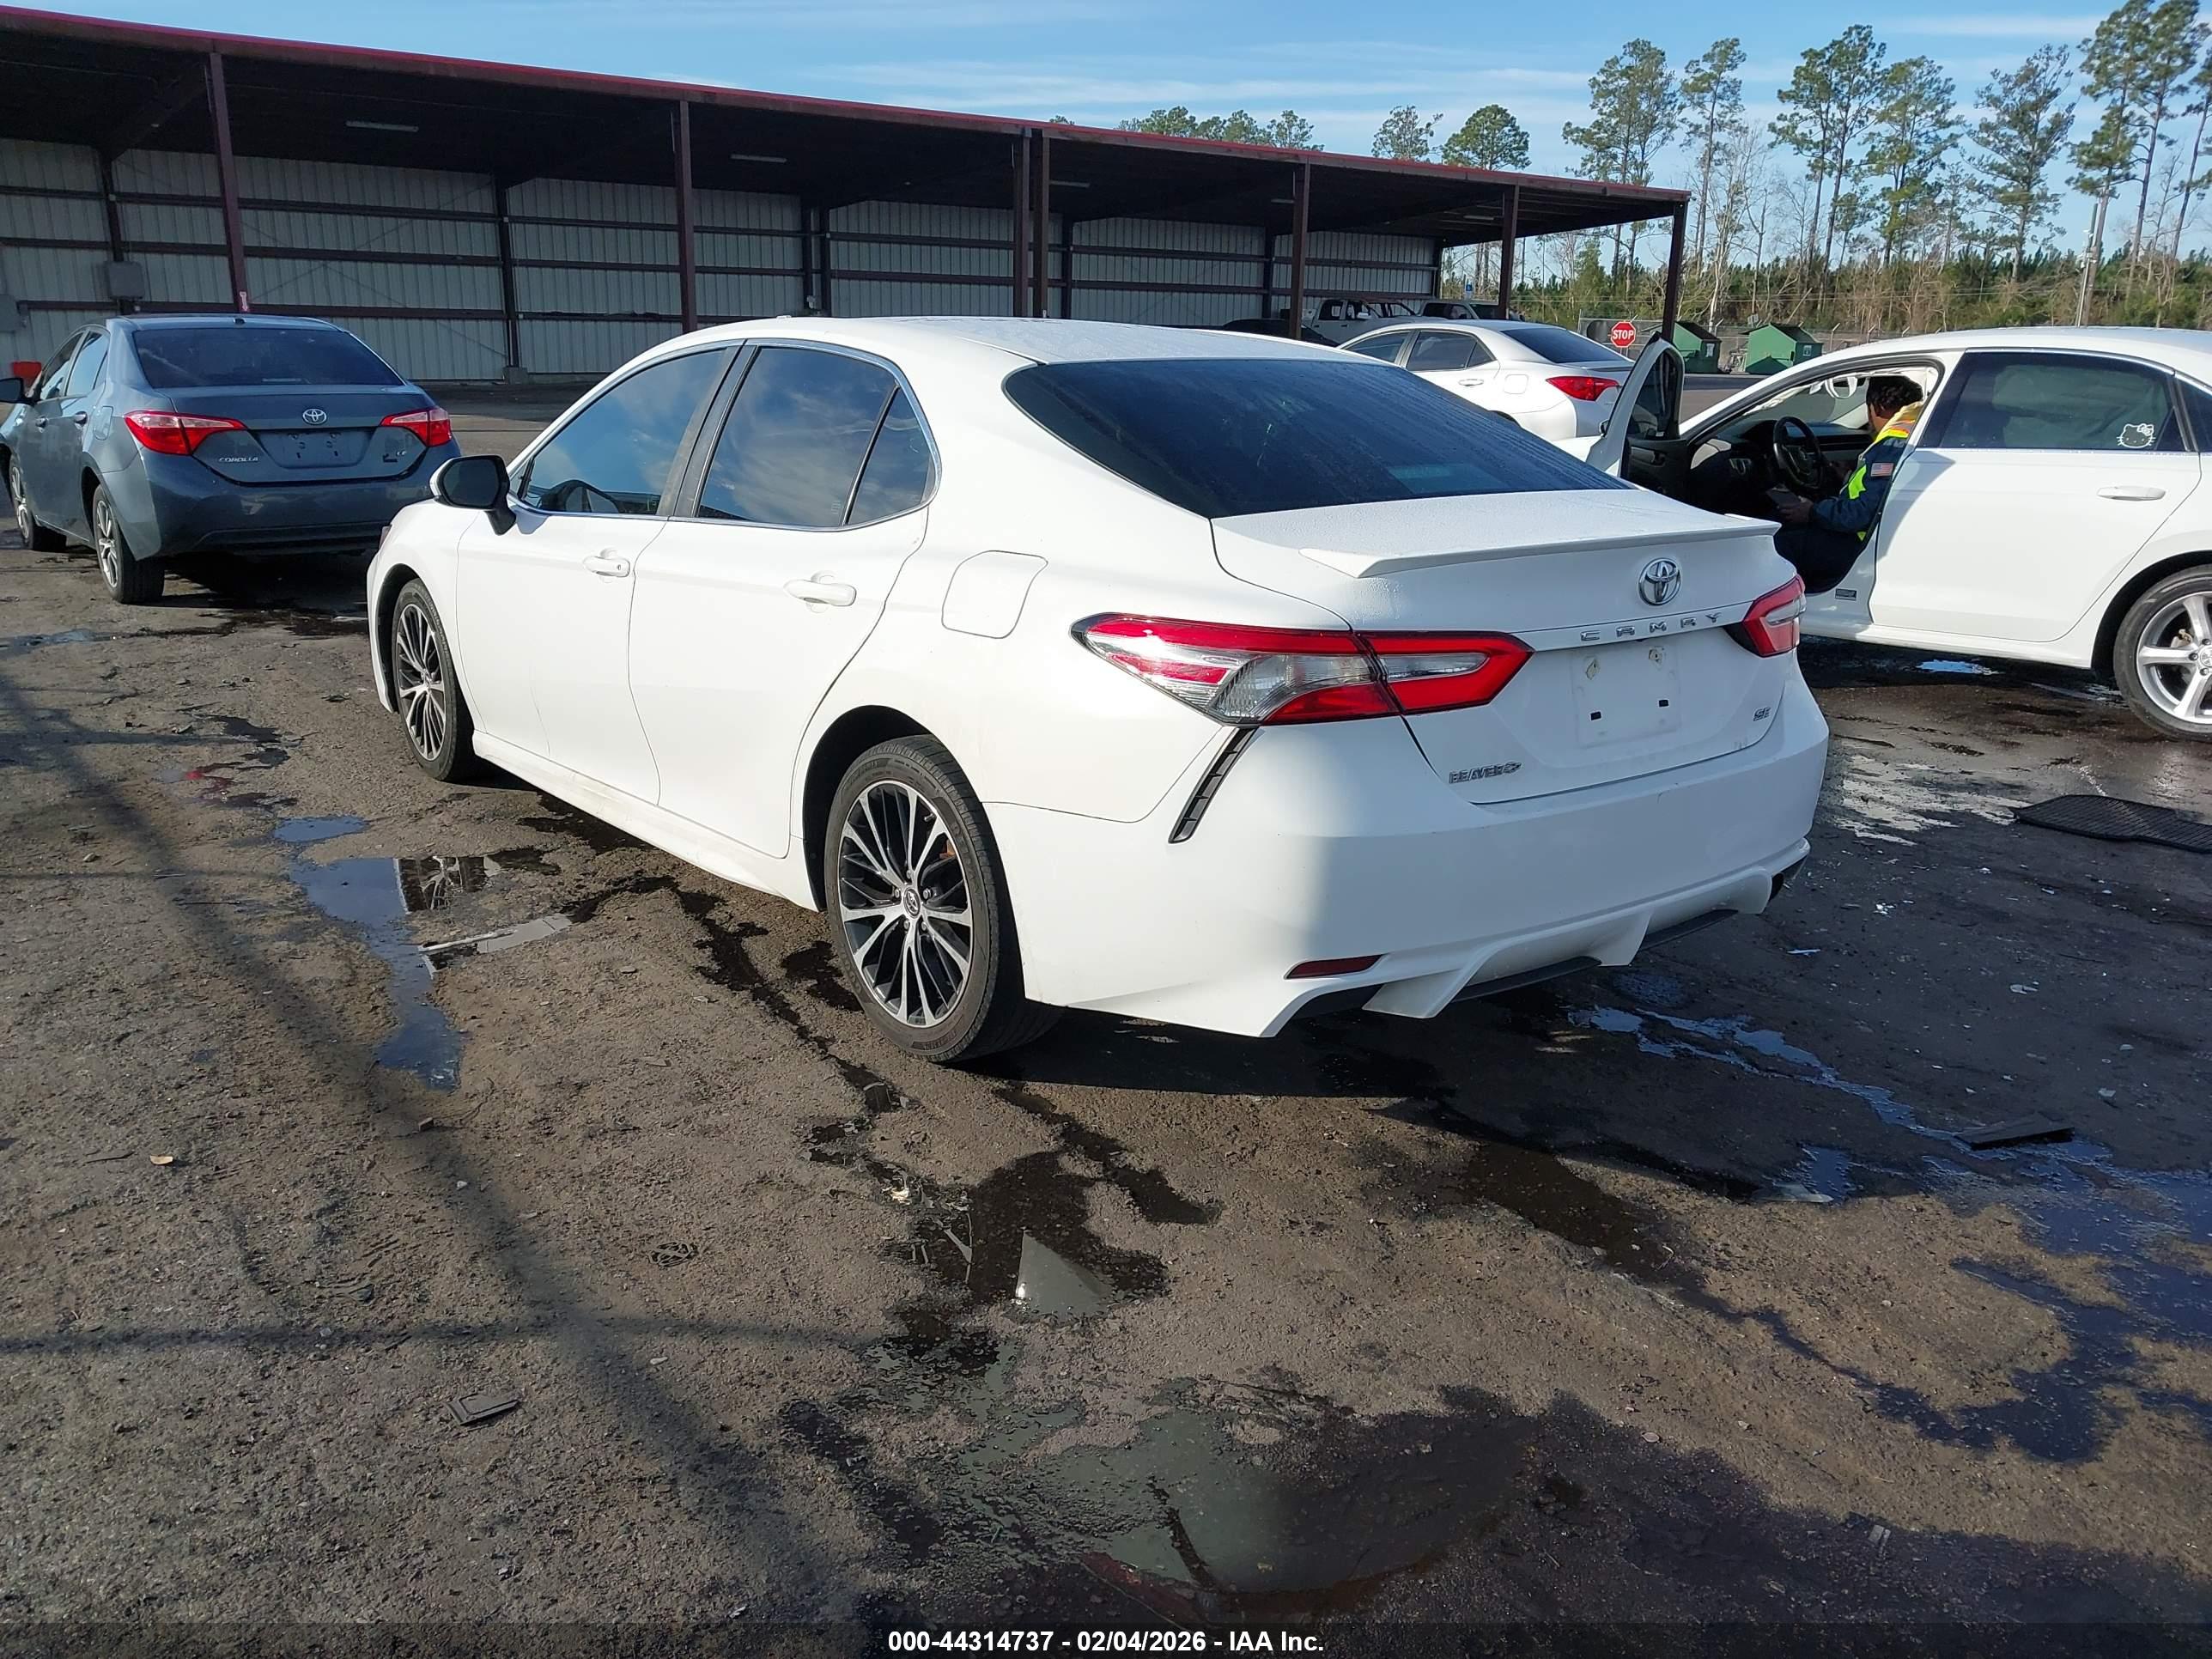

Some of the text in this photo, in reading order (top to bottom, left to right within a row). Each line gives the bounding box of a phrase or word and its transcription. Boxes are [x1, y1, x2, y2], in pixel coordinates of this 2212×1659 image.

[1613, 329, 1634, 340] STOP
[1580, 611, 1723, 641] CAMRY
[1753, 707, 1771, 722] SE
